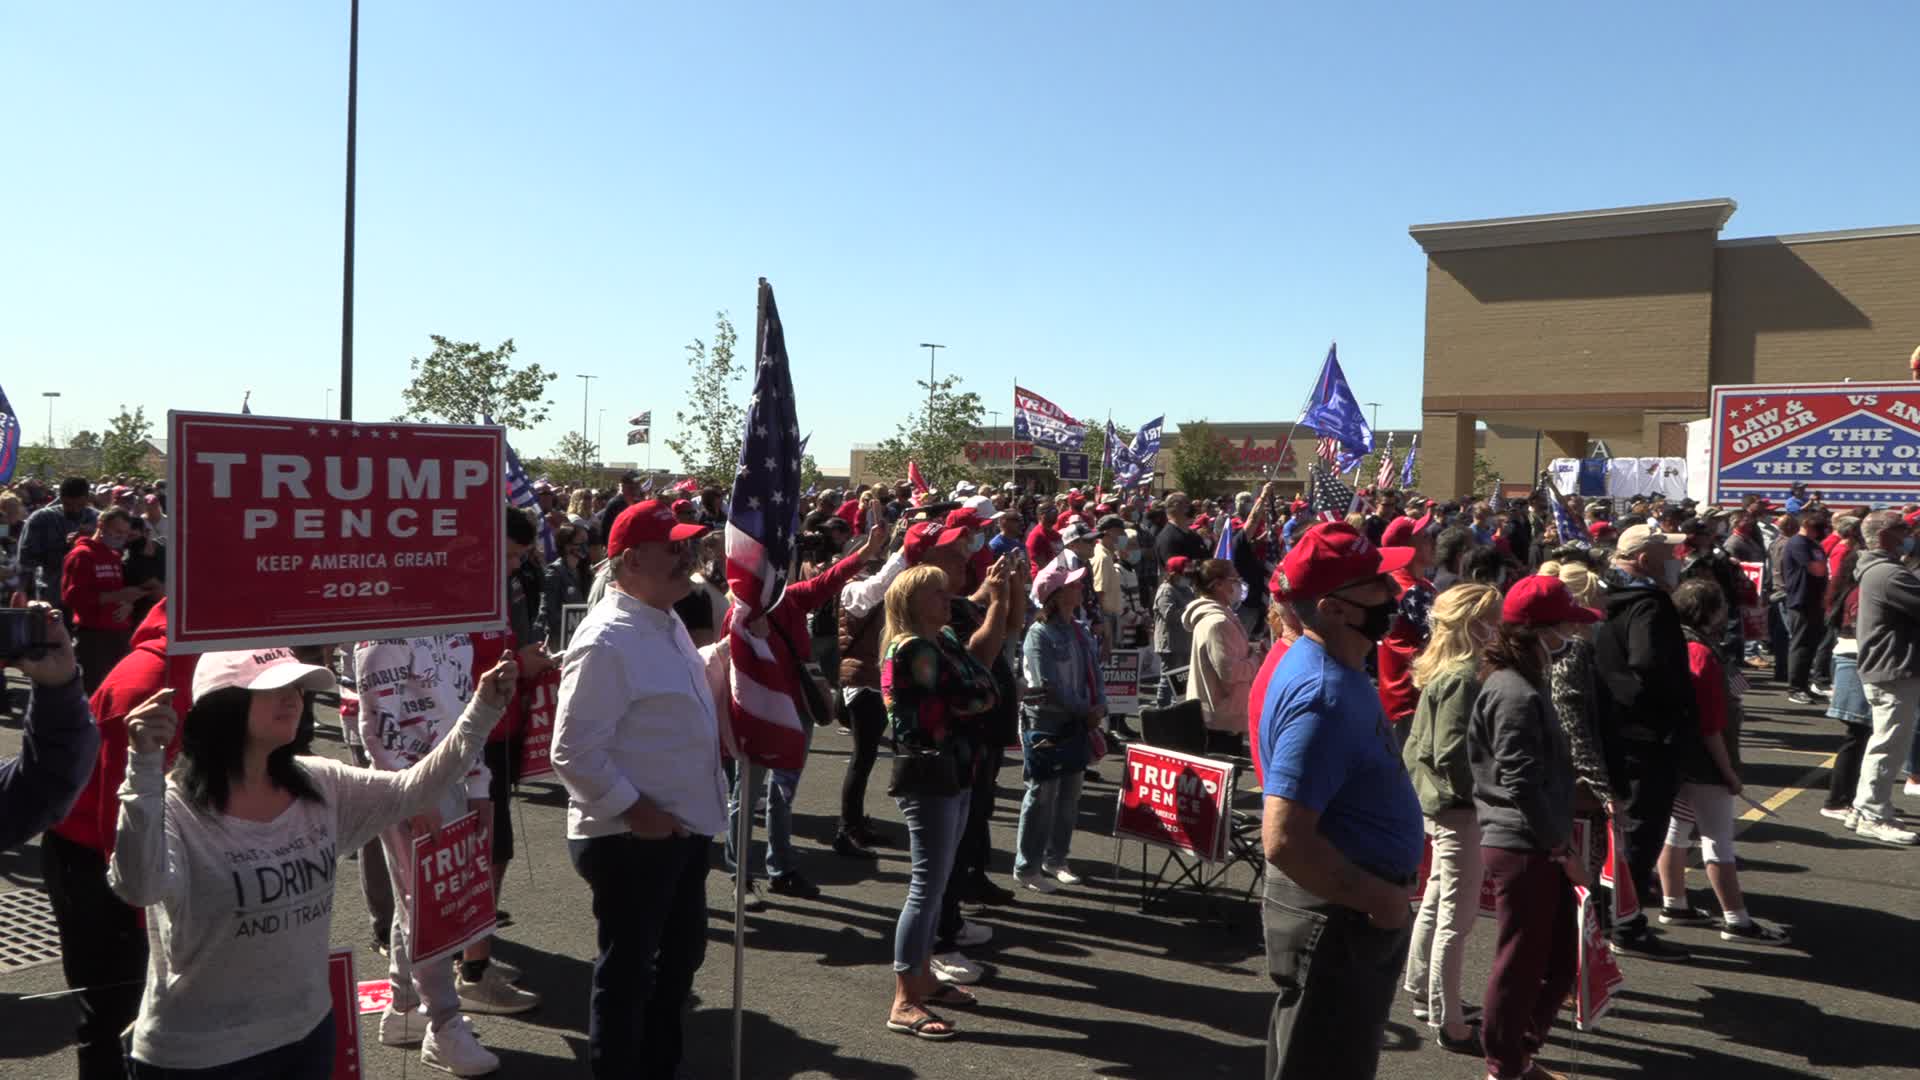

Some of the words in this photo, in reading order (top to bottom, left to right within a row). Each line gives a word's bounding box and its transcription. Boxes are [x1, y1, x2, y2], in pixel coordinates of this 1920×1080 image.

[1847, 395, 1878, 406] VS
[1729, 408, 1780, 440] LAW
[1786, 400, 1804, 415] &
[1732, 410, 1819, 453] ORDER
[1828, 428, 1893, 442] THE
[1786, 446, 1884, 459] FIGHT
[196, 452, 489, 500] TRUMP
[1753, 462, 1814, 475] THE
[243, 508, 458, 540] PENCE
[256, 555, 303, 572] KEEP
[311, 553, 387, 570] AMERICA
[394, 551, 448, 567] GREAT!
[252, 649, 287, 665] hair
[402, 696, 435, 714] 1985
[1130, 761, 1218, 799] TRUMP
[1138, 785, 1201, 813] PENCE
[231, 871, 245, 908] I
[234, 915, 280, 937] AND
